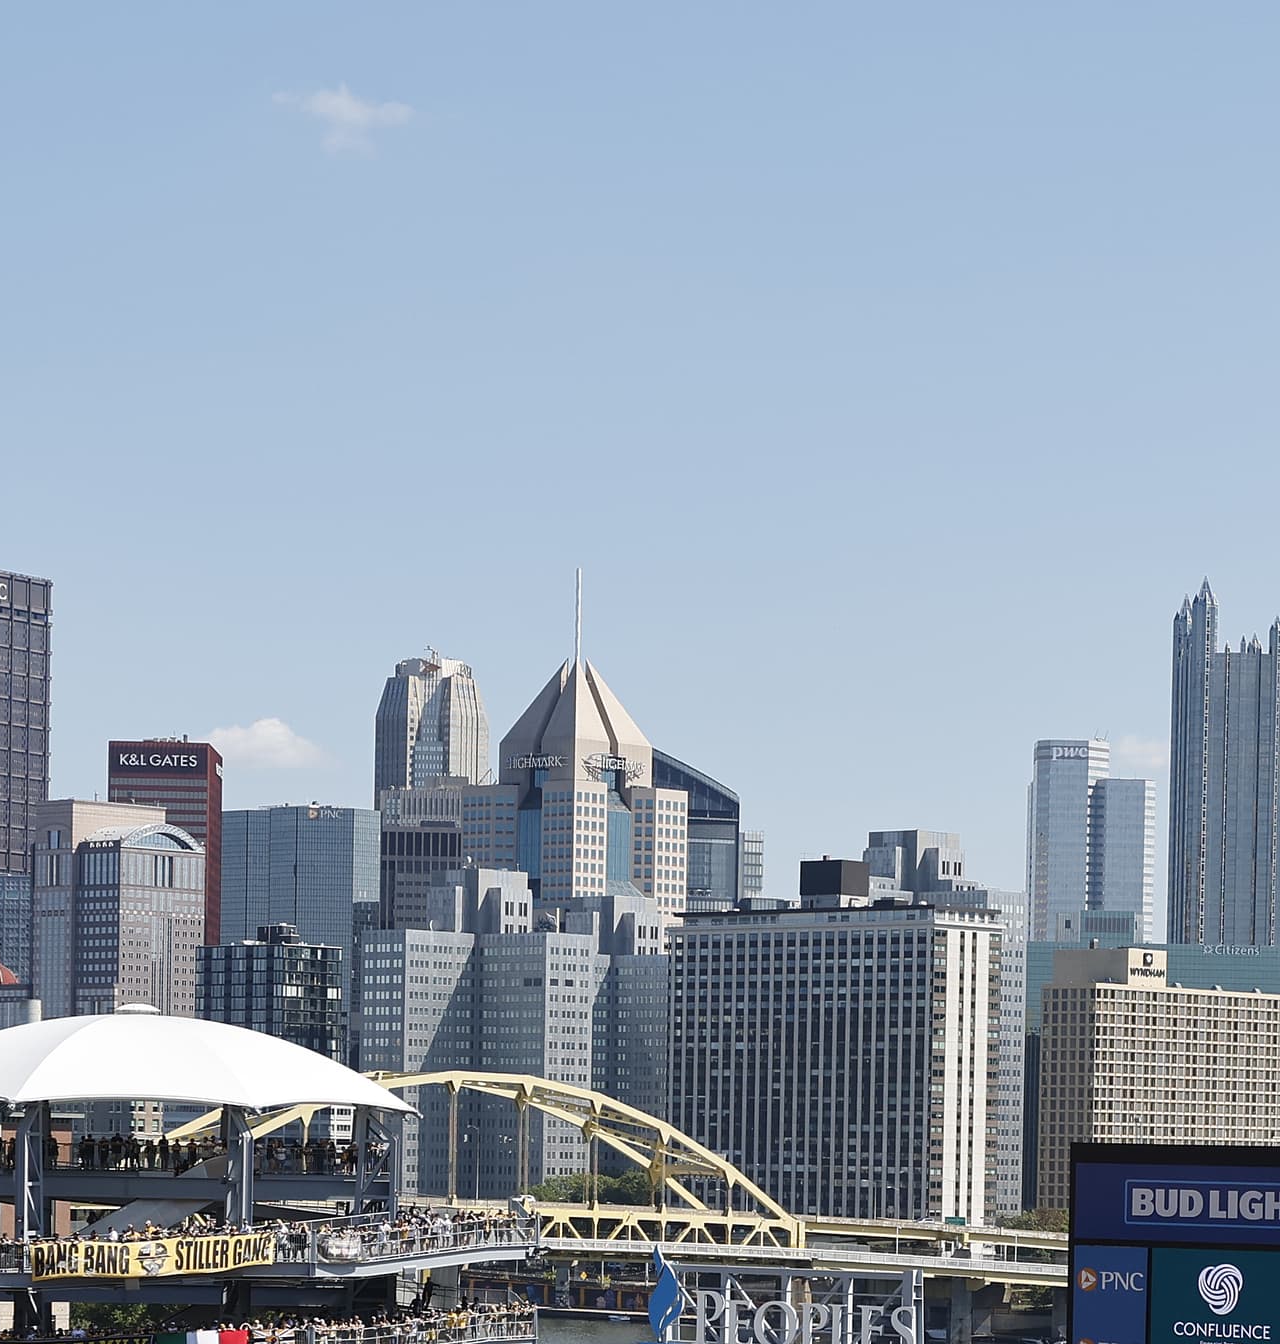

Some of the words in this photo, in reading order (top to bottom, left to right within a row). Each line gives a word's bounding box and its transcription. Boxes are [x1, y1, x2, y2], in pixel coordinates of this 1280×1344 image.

[119, 753, 147, 767] K&L
[149, 754, 198, 768] GATES
[1052, 745, 1088, 761] pwc
[321, 808, 344, 820] PNC
[1214, 944, 1261, 957] Citizens
[1129, 967, 1166, 979] WYNDHAM
[1131, 1188, 1204, 1219] BUD
[34, 1243, 80, 1277] BANG
[84, 1244, 130, 1275] BANG
[174, 1237, 229, 1271] STILLER
[232, 1233, 271, 1266] GANG
[1101, 1271, 1144, 1292] PNC
[1173, 1320, 1271, 1340] CONFLUENCE
